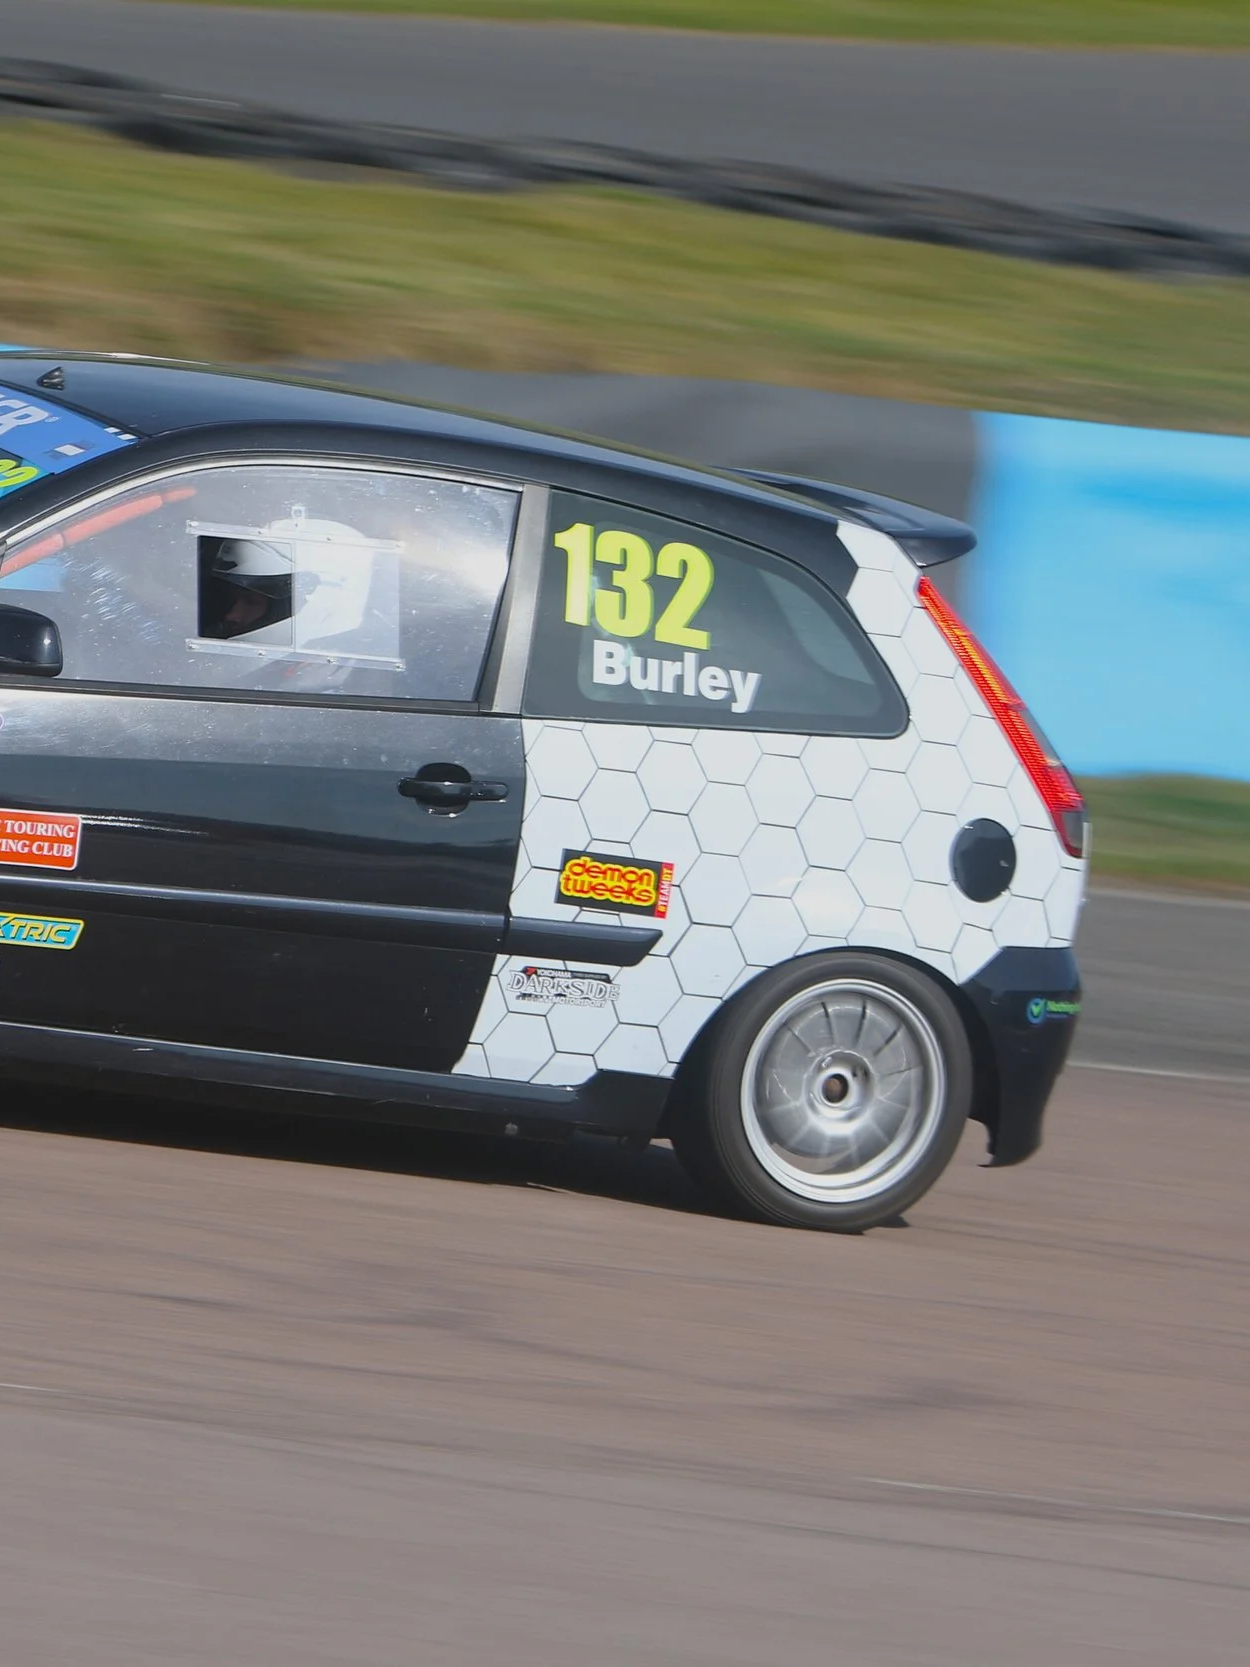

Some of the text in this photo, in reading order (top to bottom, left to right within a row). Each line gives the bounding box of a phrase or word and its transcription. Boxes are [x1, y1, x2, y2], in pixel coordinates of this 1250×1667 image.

[554, 523, 715, 650] 132
[593, 640, 761, 713] Burley
[4, 819, 76, 839] TOURING
[32, 841, 73, 857] CLUB
[566, 858, 655, 888] demon
[562, 874, 655, 903] tweeks
[507, 971, 620, 1001] DARKSIDE
